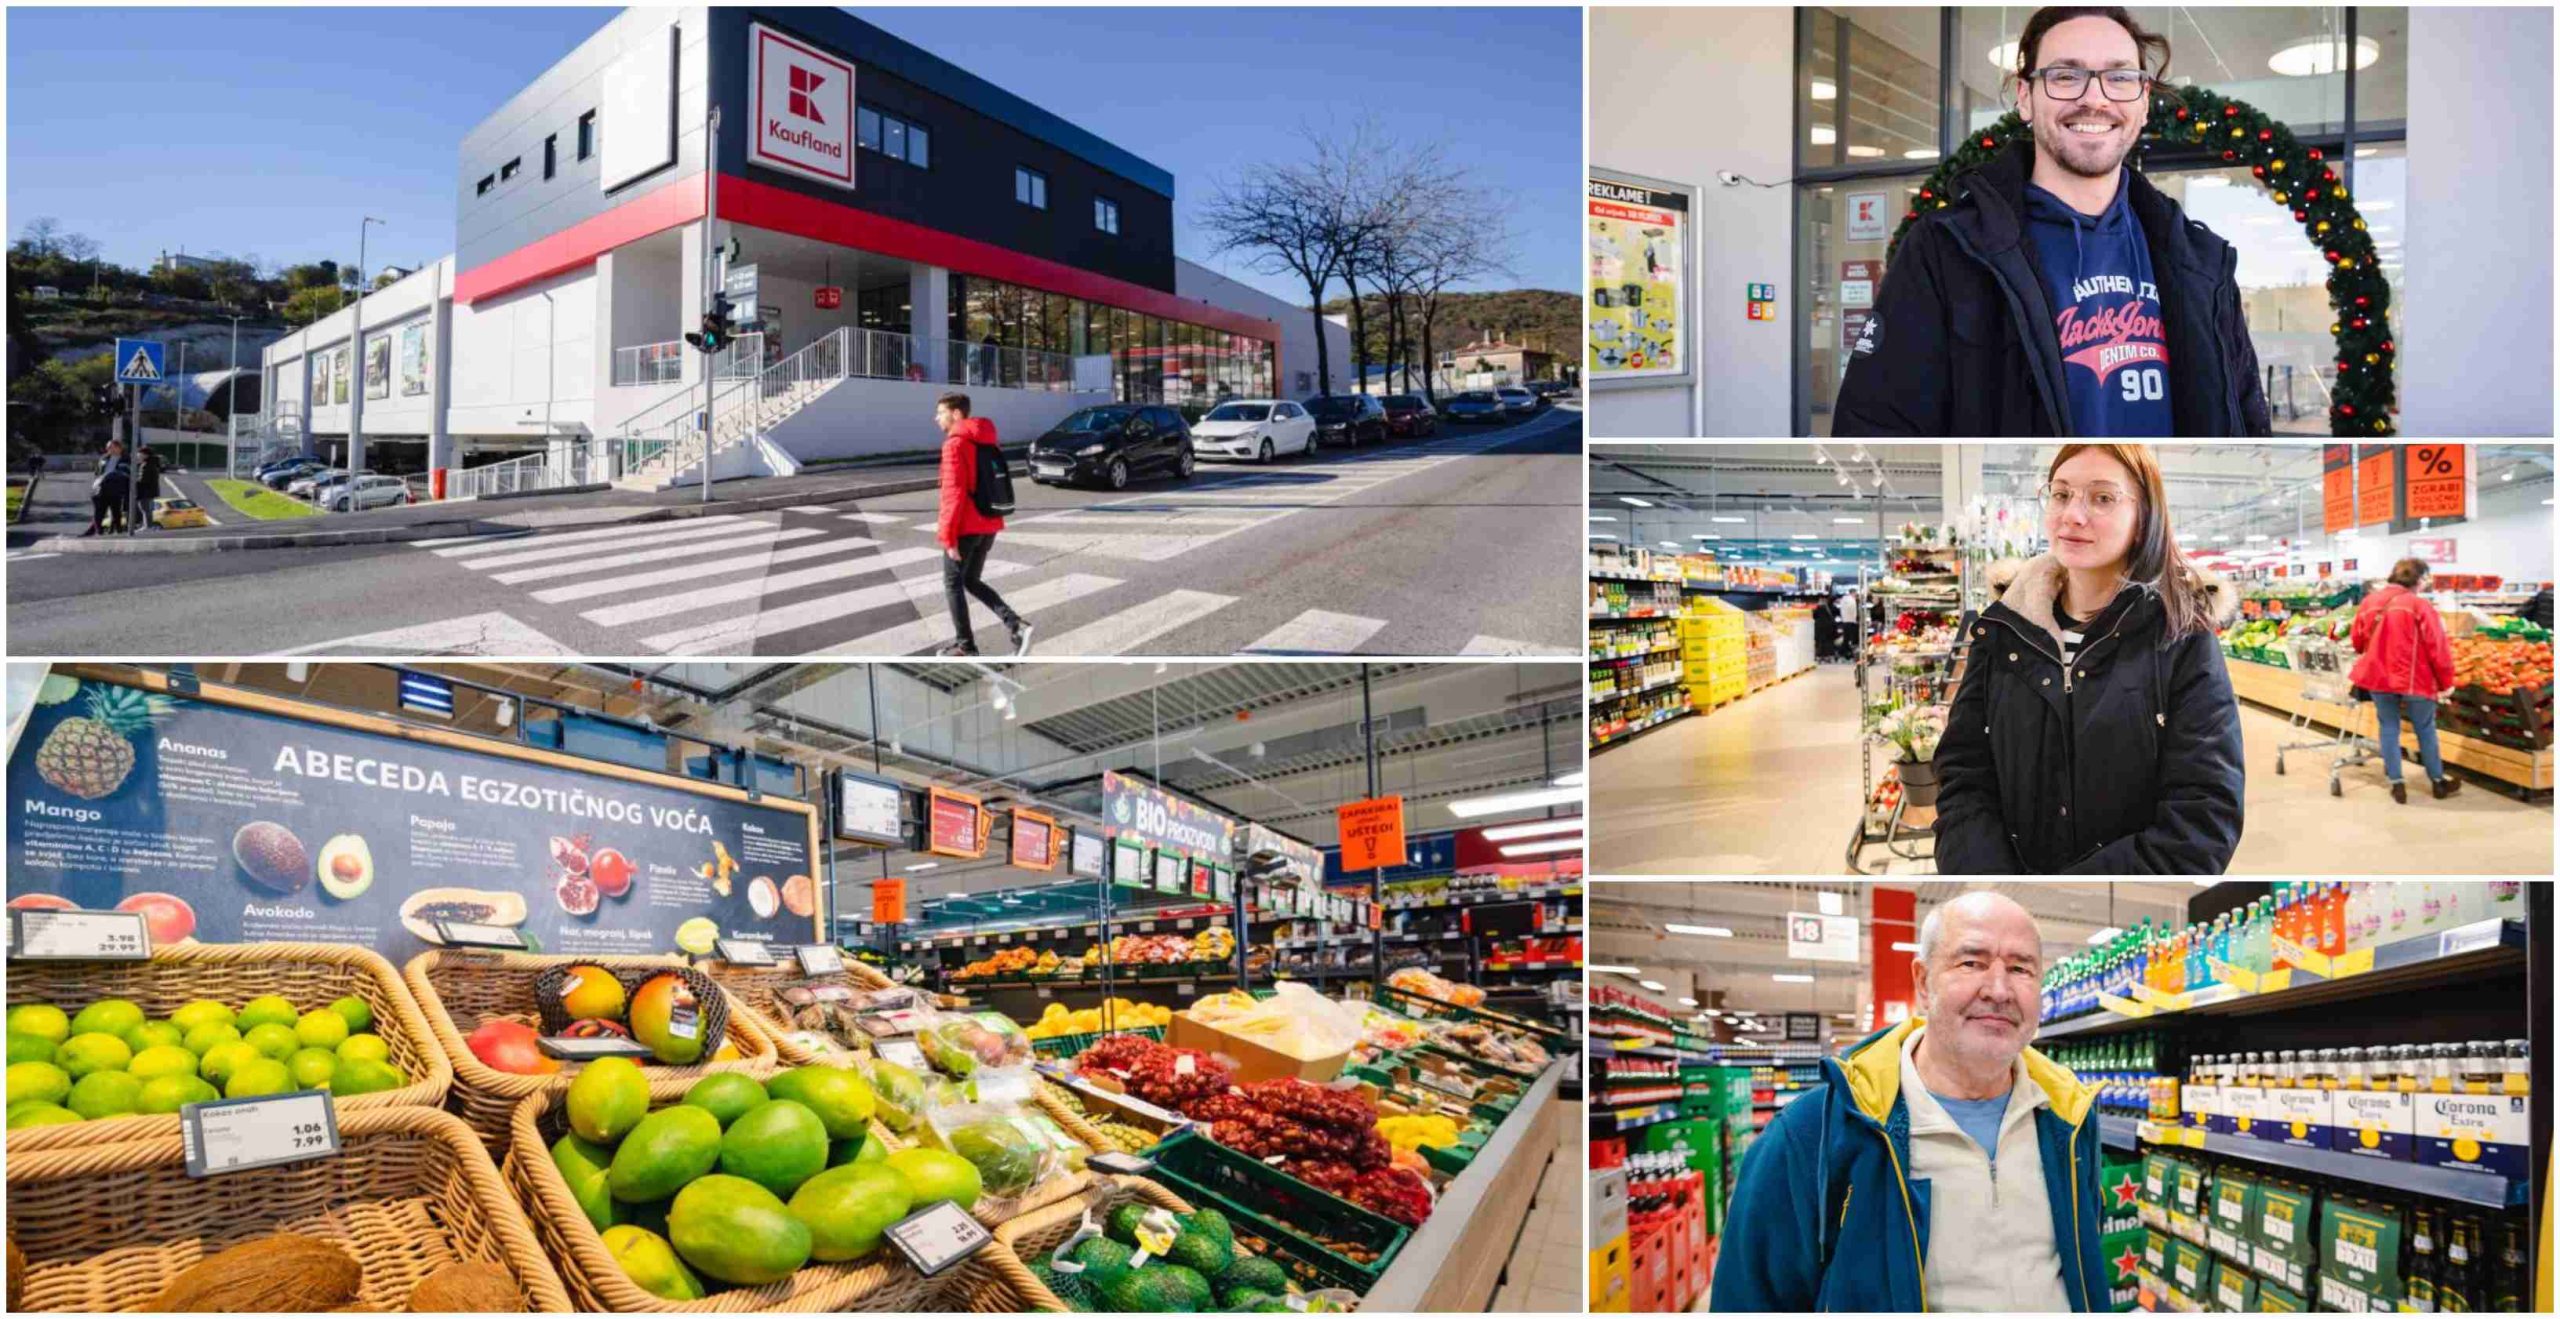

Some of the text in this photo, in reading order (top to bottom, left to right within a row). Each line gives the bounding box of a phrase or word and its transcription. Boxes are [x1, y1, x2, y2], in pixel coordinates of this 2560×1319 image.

[768, 119, 843, 158] Kaufland
[2100, 345, 2160, 371] DENIM CO.
[2121, 368, 2163, 401] 90
[2413, 483, 2459, 494] ZGRABI
[158, 737, 227, 759] Ananas
[274, 746, 450, 797] ABECEDA
[460, 775, 643, 825] EGZOTIČNOG
[650, 806, 714, 836] VOĆA
[25, 799, 101, 822] Mango
[1136, 797, 1166, 837] BIO
[411, 815, 456, 832] Papaja
[243, 904, 315, 919] Avokado
[1794, 920, 1820, 941] 18
[2348, 1095, 2392, 1110] Corona
[2434, 1098, 2498, 1117] Corona
[293, 1123, 321, 1135] 1.06
[2450, 1116, 2484, 1128] Extra
[292, 1135, 323, 1149] 7.99
